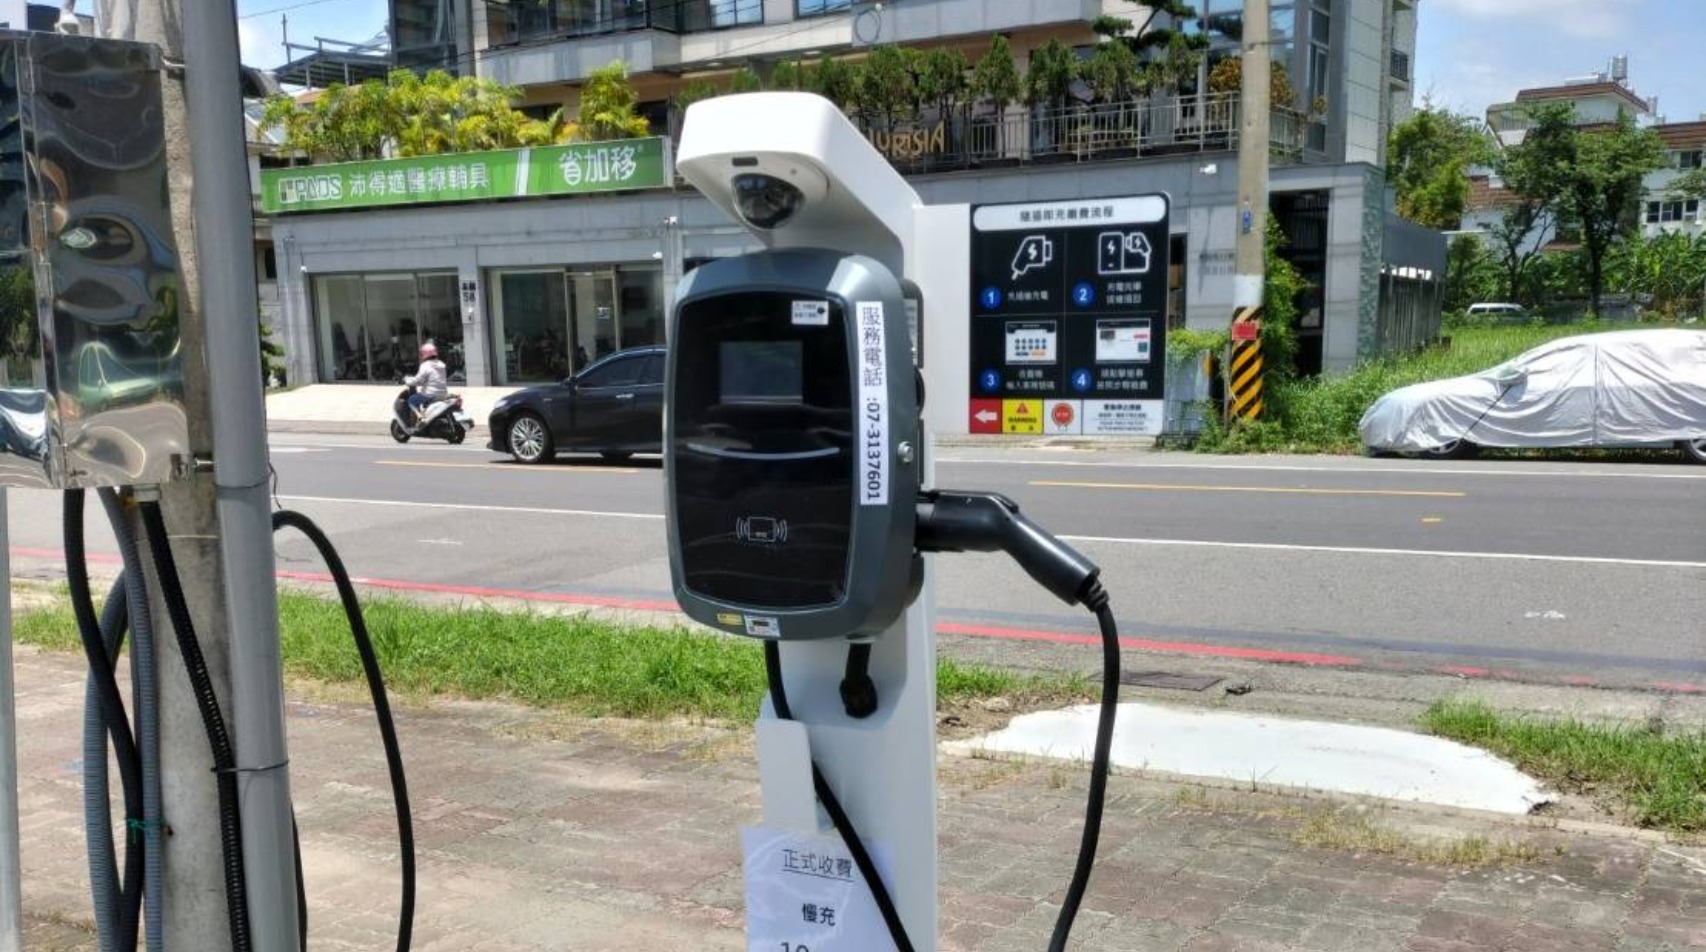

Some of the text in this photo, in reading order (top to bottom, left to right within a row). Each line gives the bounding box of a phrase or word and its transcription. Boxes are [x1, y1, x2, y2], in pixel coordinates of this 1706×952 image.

[349, 162, 489, 198] 沛得適醫療輔具
[559, 145, 637, 186] 省加移
[1079, 289, 1087, 301] 2
[1077, 374, 1085, 386] 4
[862, 307, 883, 500] 服務電話 :07-3137601
[782, 849, 852, 878] 正式收費
[802, 903, 836, 927] 慢充
